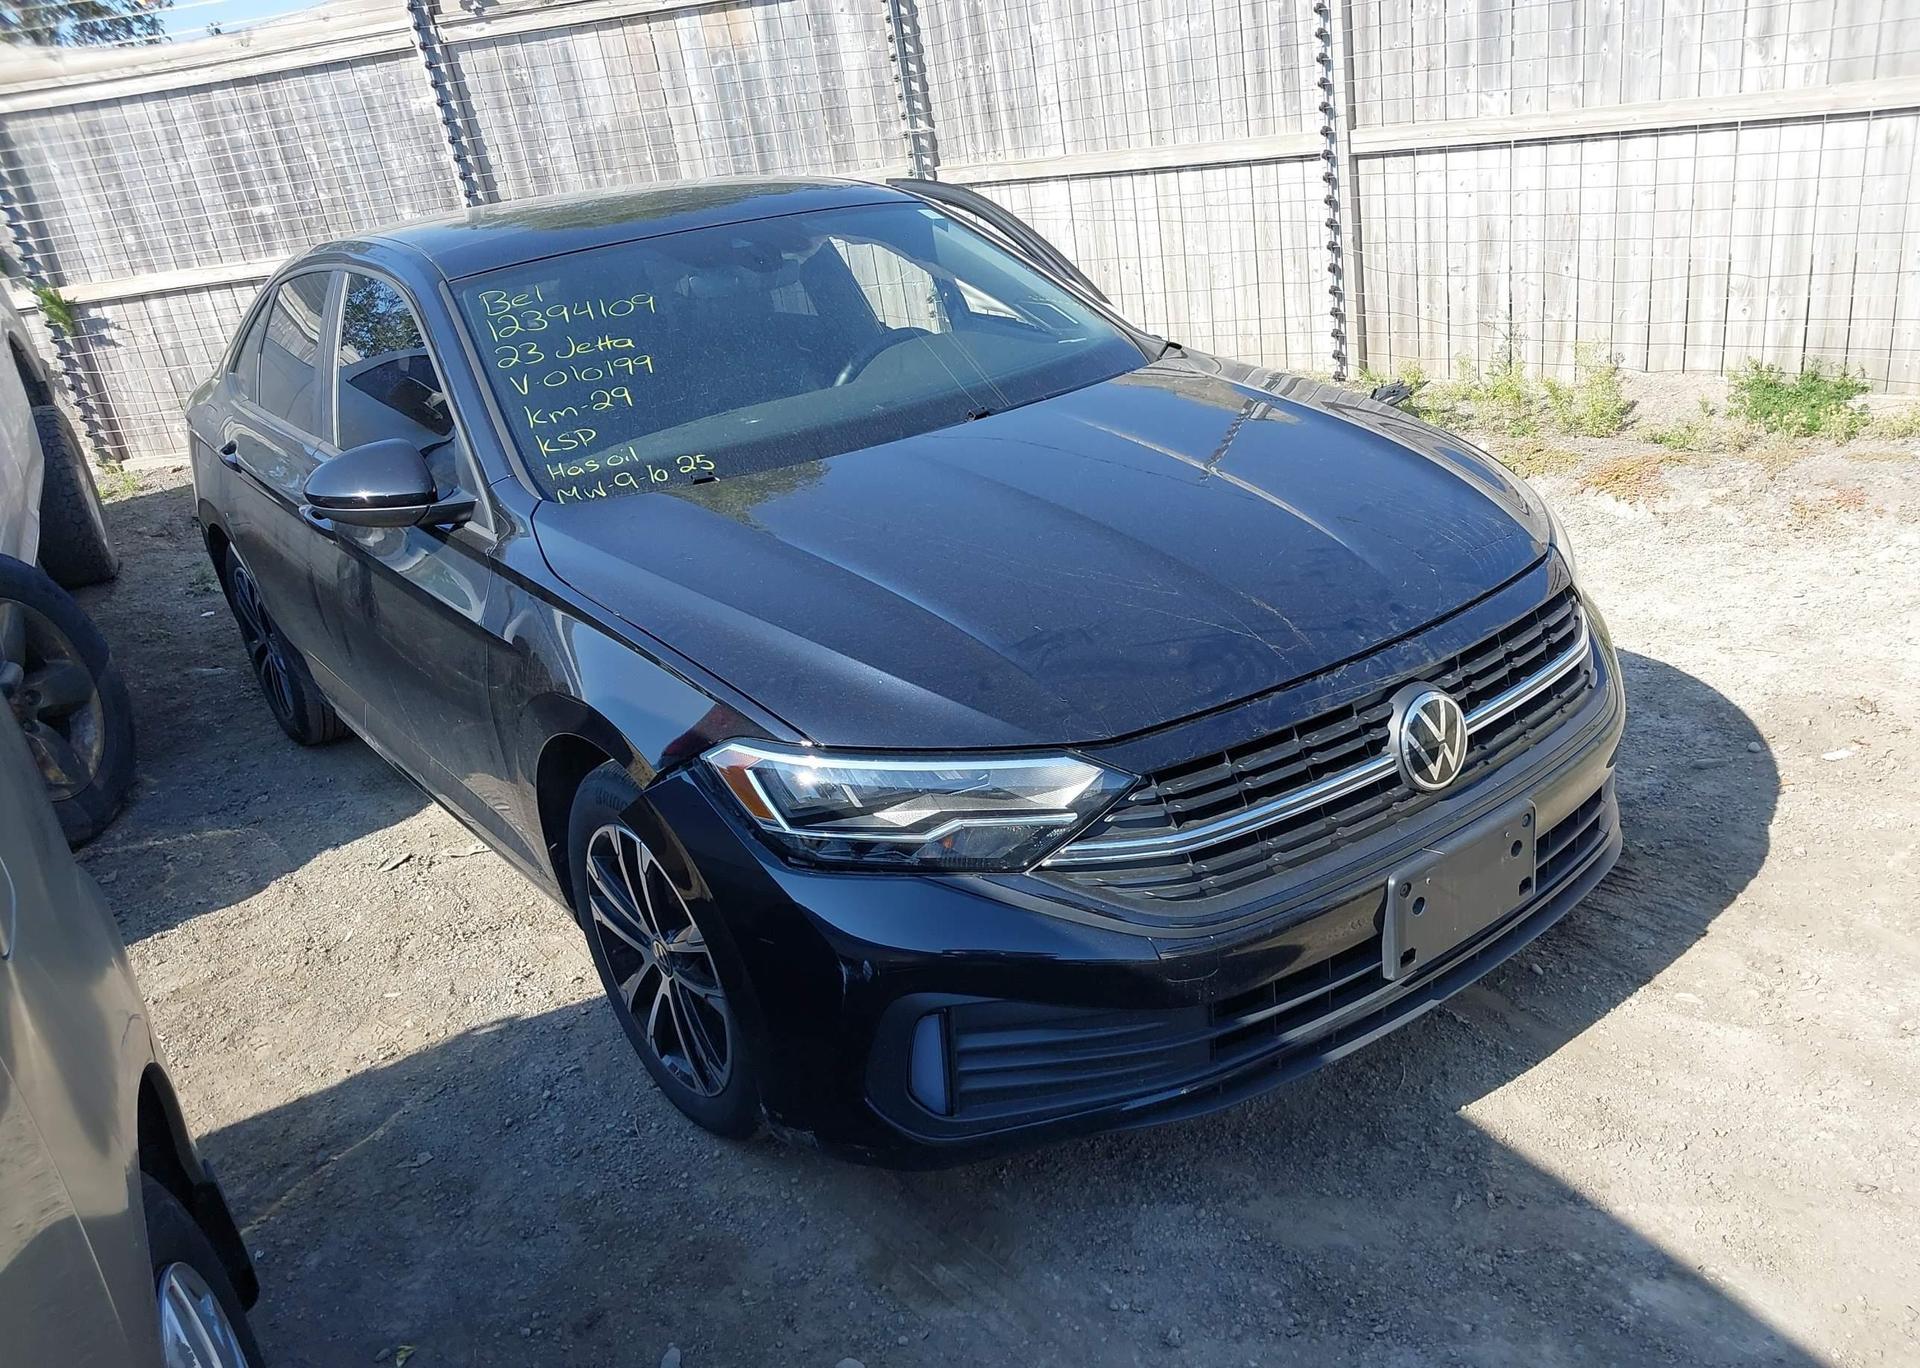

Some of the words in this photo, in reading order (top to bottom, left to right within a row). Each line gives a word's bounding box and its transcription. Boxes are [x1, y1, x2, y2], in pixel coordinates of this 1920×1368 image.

[487, 293, 656, 342] 12394109
[495, 342, 545, 369] 23
[556, 334, 635, 359] Jetta
[676, 454, 716, 474] 25
